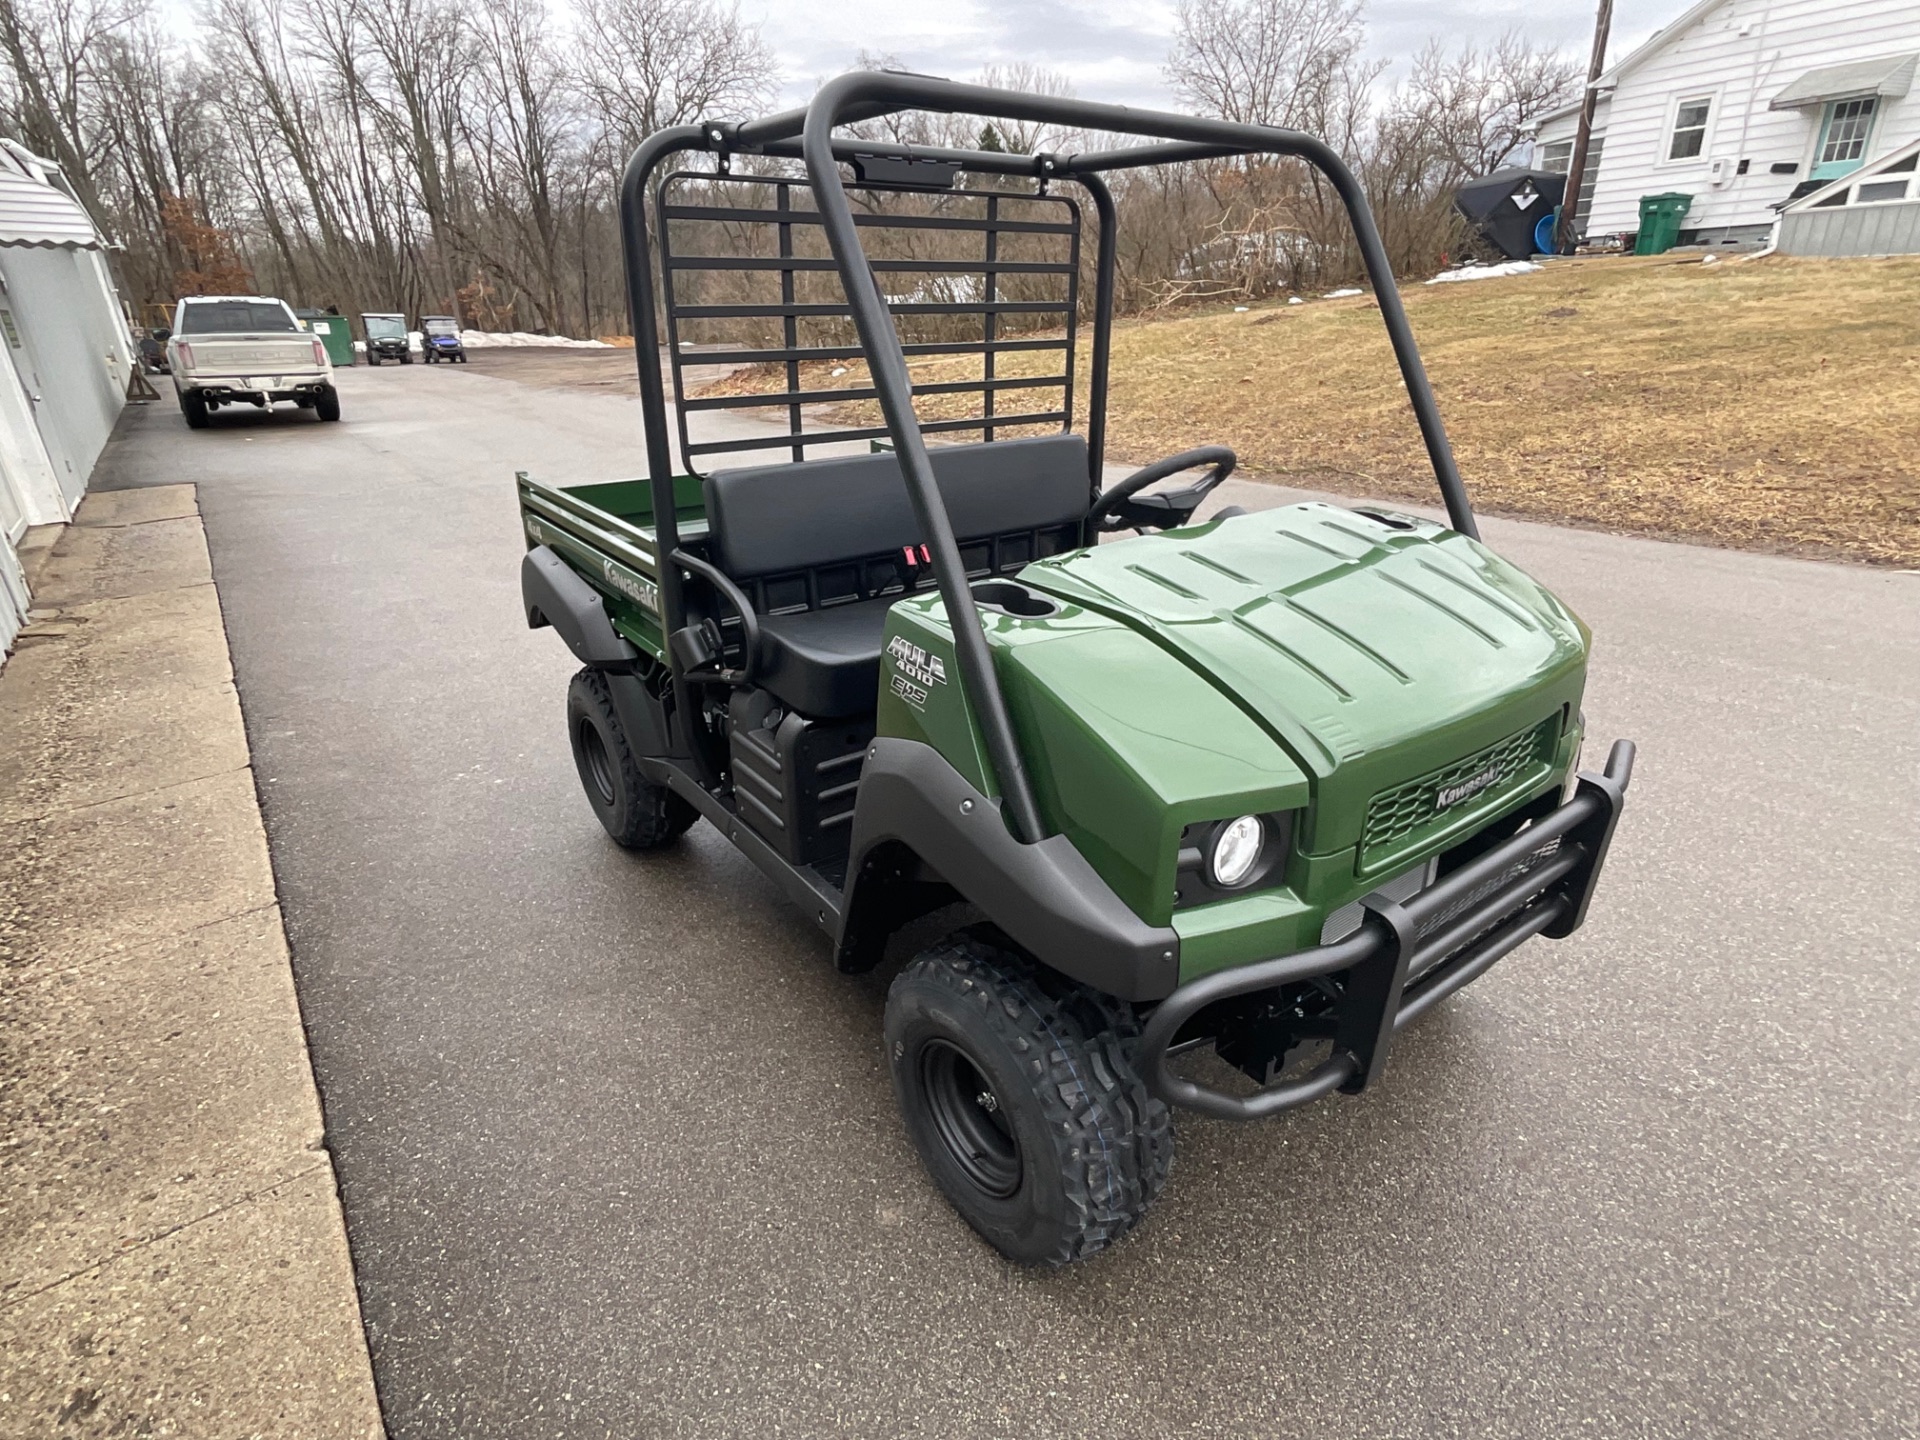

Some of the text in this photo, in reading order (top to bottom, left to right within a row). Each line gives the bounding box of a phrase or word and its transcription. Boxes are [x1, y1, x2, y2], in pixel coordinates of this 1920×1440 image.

[603, 559, 659, 613] Kawasaki
[886, 635, 948, 686] MULE
[896, 659, 935, 688] 4010
[1436, 762, 1501, 809] Kawasaki
